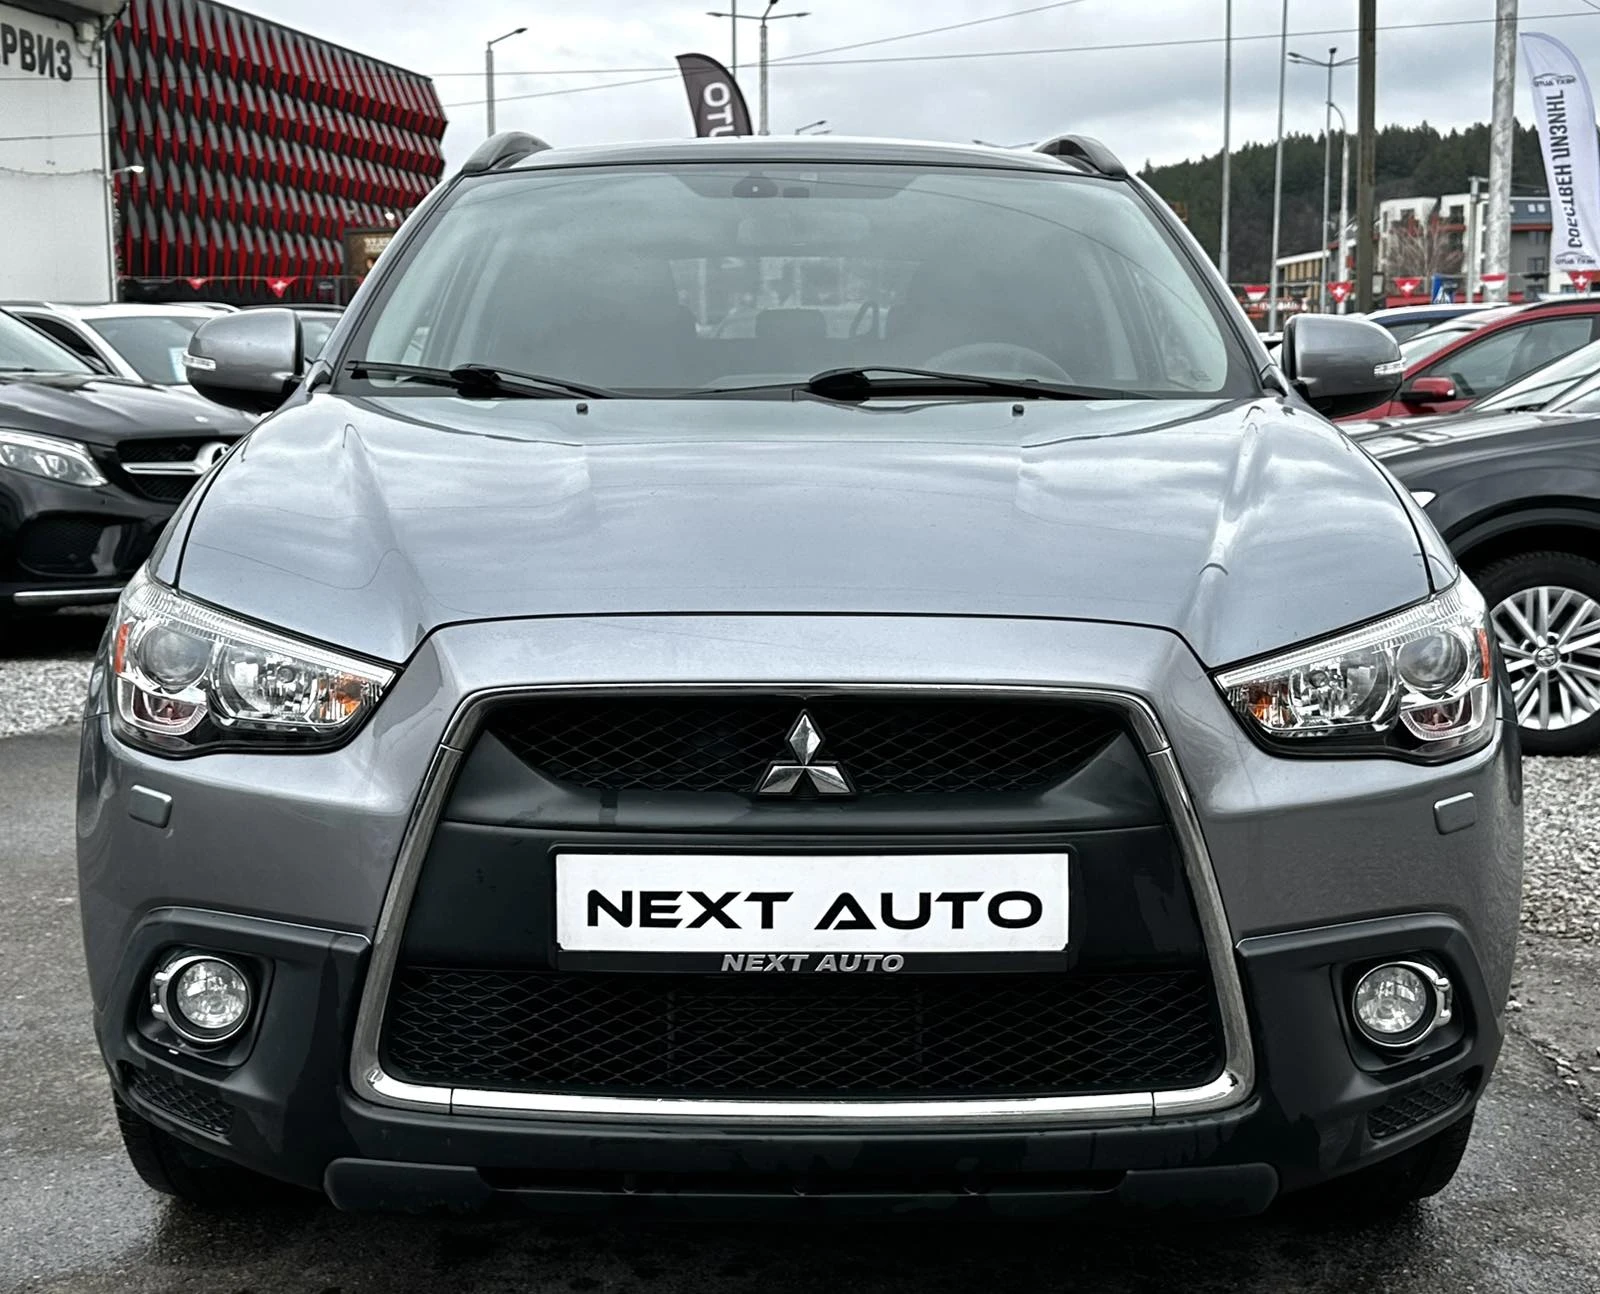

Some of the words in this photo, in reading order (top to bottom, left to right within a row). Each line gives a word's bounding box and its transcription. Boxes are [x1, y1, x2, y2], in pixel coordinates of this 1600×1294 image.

[0, 23, 73, 82] РВИЗ
[586, 889, 794, 930] NEXT
[813, 889, 1044, 930] AUTO
[720, 953, 809, 973] NEXT
[814, 953, 906, 973] AUTO
